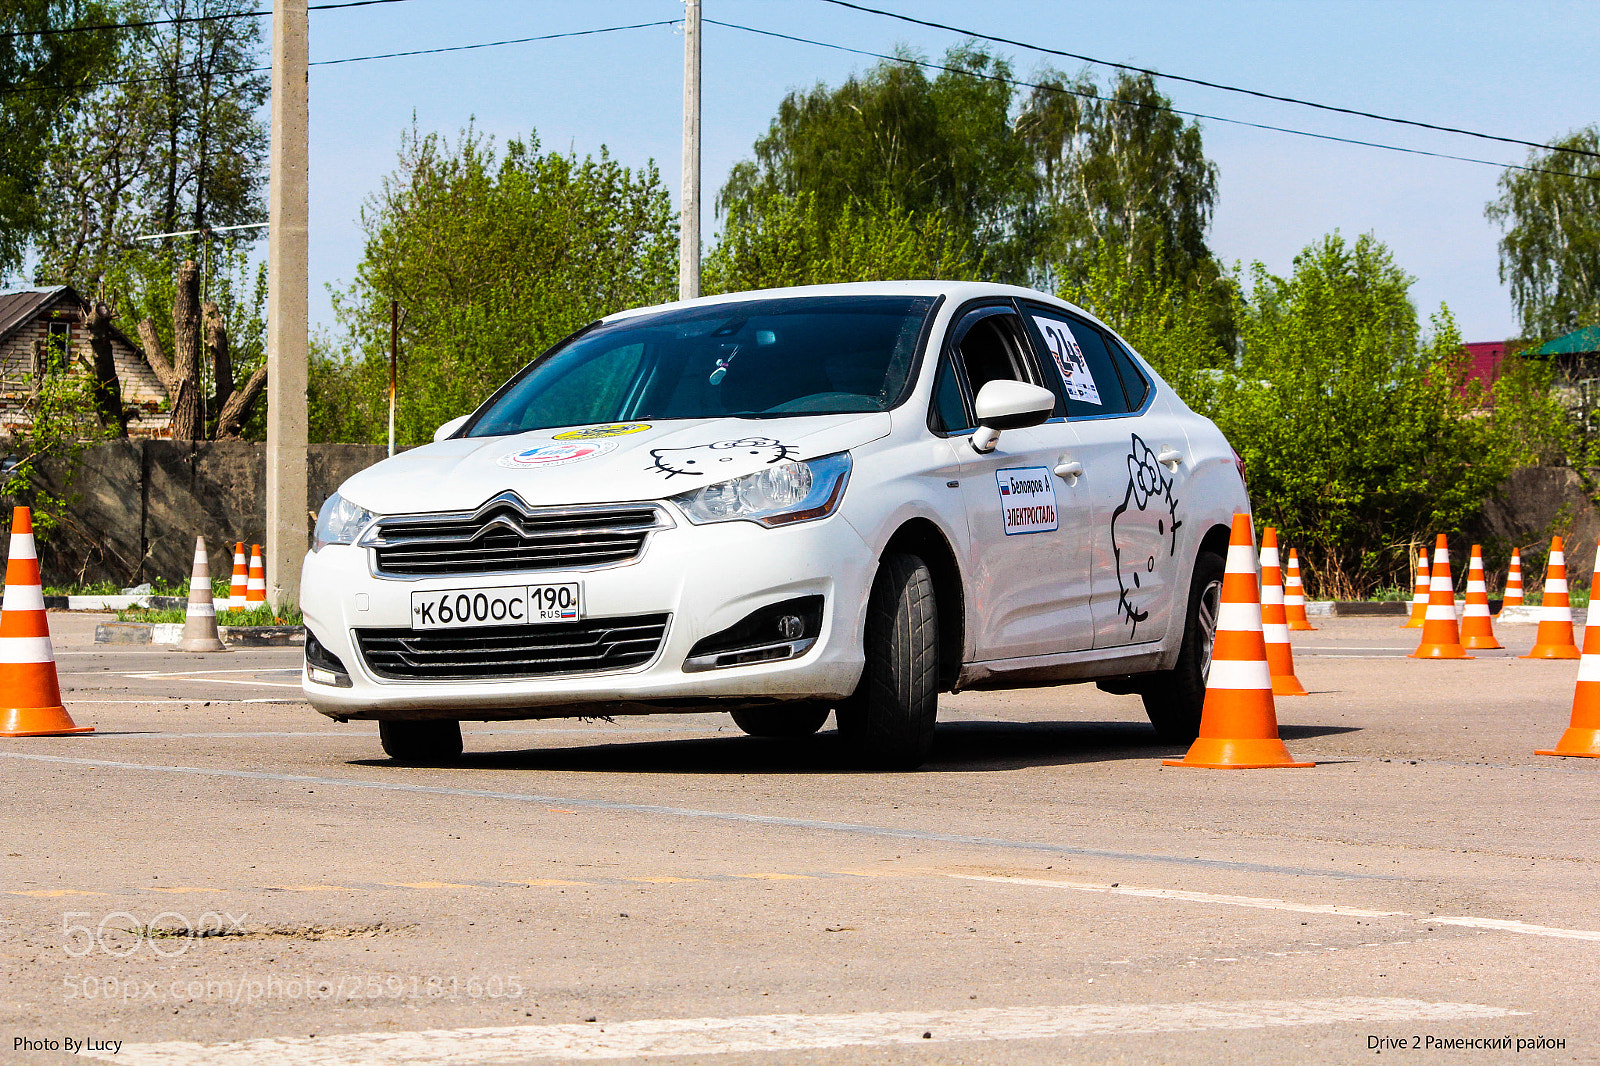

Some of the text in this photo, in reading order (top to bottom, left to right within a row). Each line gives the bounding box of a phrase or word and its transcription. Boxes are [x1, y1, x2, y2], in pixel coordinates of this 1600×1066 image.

[1045, 325, 1084, 374] 24
[1007, 505, 1055, 527] ЭЛЕКТРОСТАЛЬ
[531, 586, 571, 610] 190
[540, 610, 561, 619] RUS
